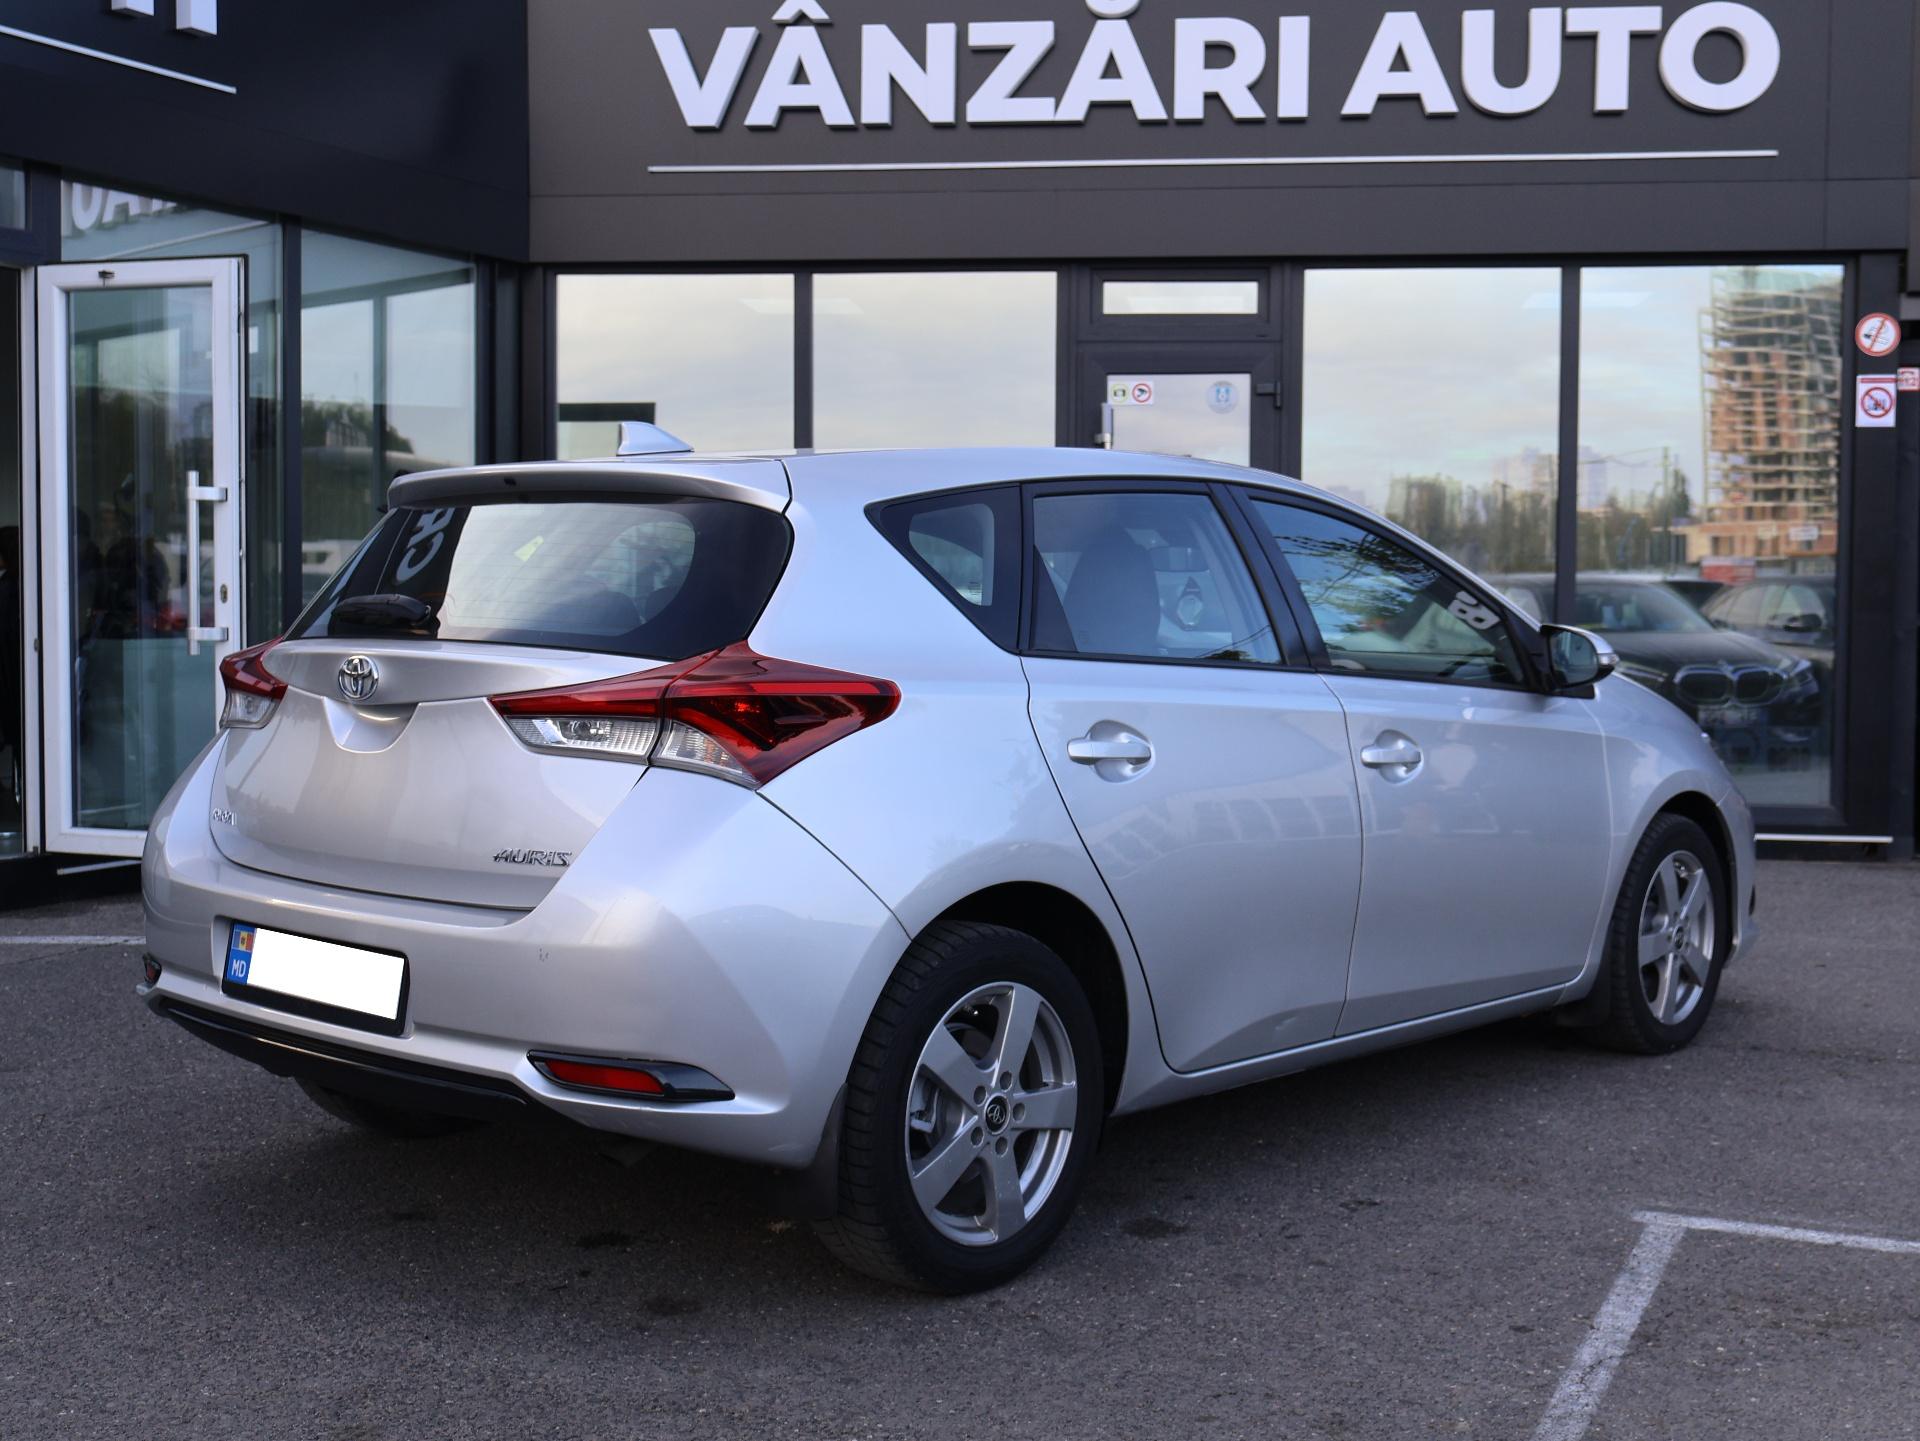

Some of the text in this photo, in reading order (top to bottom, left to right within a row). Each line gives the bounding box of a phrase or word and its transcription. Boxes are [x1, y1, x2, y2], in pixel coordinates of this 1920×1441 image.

[648, 0, 1781, 129] VÂNZĂRI AUTO
[493, 848, 573, 867] AURIS
[231, 959, 247, 978] MD
